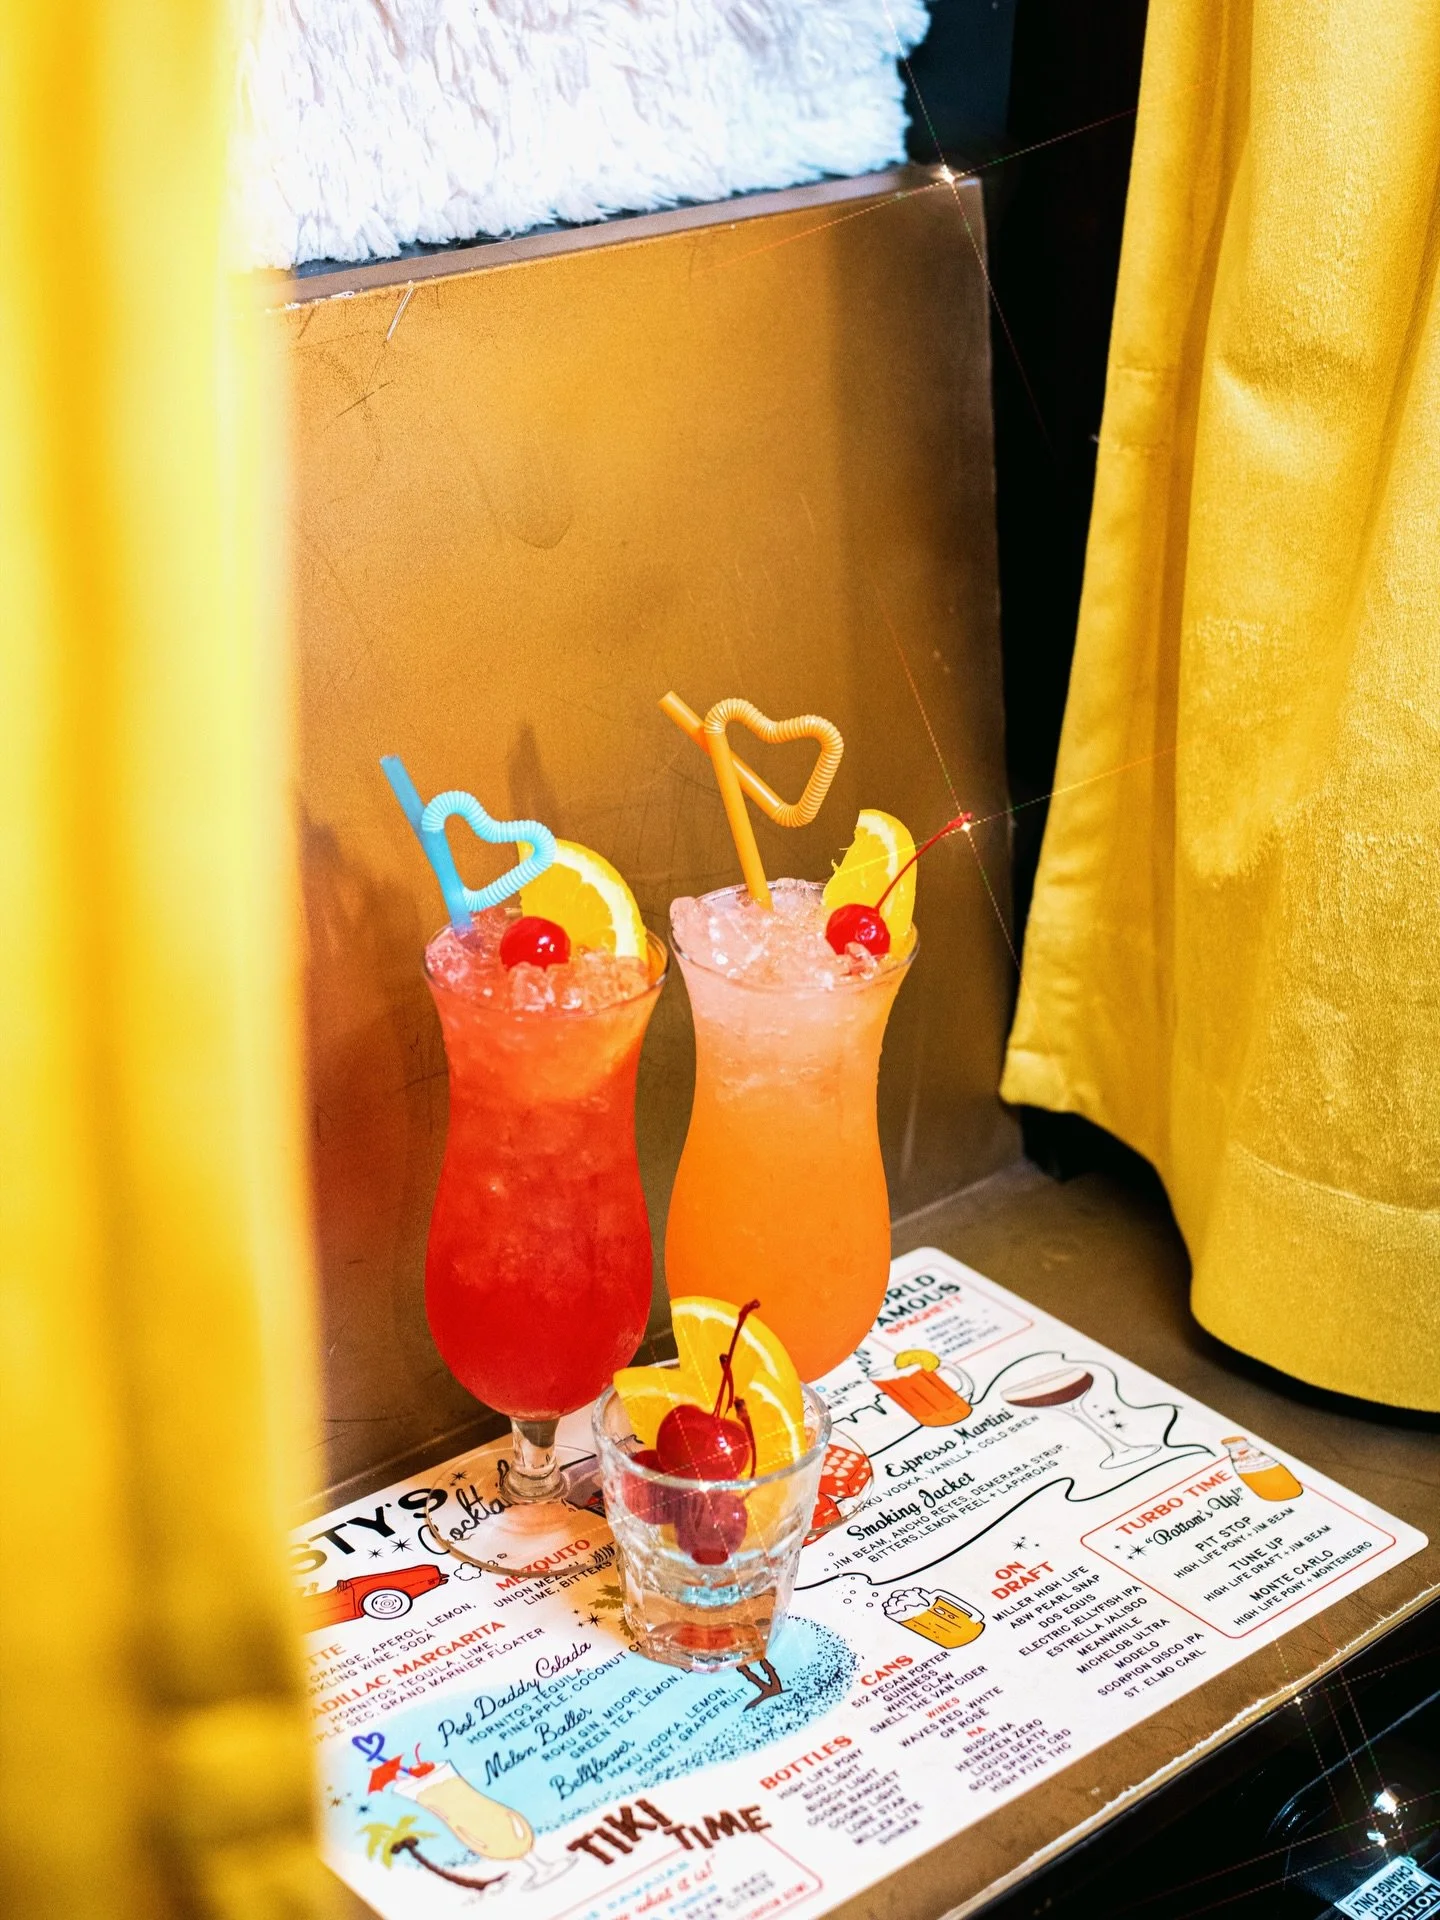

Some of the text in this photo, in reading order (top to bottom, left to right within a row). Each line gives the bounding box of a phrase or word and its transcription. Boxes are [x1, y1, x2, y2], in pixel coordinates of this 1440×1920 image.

[877, 1284, 960, 1327] AMOUS
[884, 1275, 935, 1305] RLD
[883, 1415, 1039, 1497] VODKA, VANILLA, COLD BREW
[886, 1408, 1013, 1477] Espresso Martini
[833, 1445, 1069, 1570] JIM BEAM, ANCHO REYES, DEMERARA SYRUP,
[847, 1472, 976, 1541] Smoking Jacket
[958, 1460, 1059, 1519] PEEL LAPHROAIG
[1116, 1470, 1233, 1536] TURBO TIME
[1174, 1507, 1295, 1579] HIGH LIFE PONY JIM BEAM
[1195, 1516, 1252, 1552] PIT STOP
[1228, 1537, 1285, 1572] TUNE UP
[991, 1561, 1054, 1600] DRAFT
[995, 1561, 1026, 1580] ON
[1204, 1525, 1331, 1602] HIGH LIFE DRAFT JIM BEAM
[1233, 1541, 1372, 1627] HIGH LIFE PONY MONTENEGRO
[1249, 1550, 1333, 1602] MONTE CARLO
[494, 1586, 533, 1608] UNION
[524, 1586, 560, 1605] LIME,
[991, 1565, 1089, 1622] MILLER HIGH LIFE
[1009, 1574, 1100, 1629] ABW PEARL SNAP
[1038, 1593, 1096, 1629] DOS EQUIS
[372, 1602, 477, 1654] APEROL, LEMON,
[1018, 1584, 1142, 1657] ELECTRIC JELLYFISH IPA
[1046, 1597, 1148, 1658] ESTRELLA JALISCO
[1076, 1617, 1171, 1675] MICHELOB ULTRA
[1077, 1616, 1143, 1657] MEANWHILE
[361, 1633, 436, 1671] WINE, SODA
[381, 1628, 545, 1711] GRAND MARNIER FLOATER
[392, 1621, 506, 1677] MARGARITA
[861, 1655, 913, 1686] CANS
[1097, 1632, 1204, 1697] SCORPION DISCO IPA
[1114, 1640, 1160, 1670] MODELO
[1124, 1648, 1206, 1699] ST. ELMO CARL
[328, 1661, 461, 1723] HORNITOS TEQUILA,
[437, 1641, 592, 1748] Pool Daddy Colada
[467, 1667, 590, 1744] HORNITOS TEQUILA,
[498, 1652, 627, 1740] PINEAPPLE, COCONUT
[851, 1651, 951, 1709] 512 PECAN PORTER
[870, 1665, 988, 1734] SMELL THE VAN CIDER
[882, 1669, 939, 1702] GUINNESS
[884, 1671, 955, 1713] WHITE CLAW
[541, 1686, 648, 1762] ROKU MIDORI,
[570, 1676, 683, 1759] GREEN TEA, LEMON,
[607, 1687, 731, 1779] HAKU VODKA, LEMON,
[635, 1687, 749, 1776] HONEY, GRAPEFRUIT
[898, 1686, 1004, 1748] WAVES RED, WHITE
[925, 1697, 960, 1719] WINES
[940, 1727, 957, 1739] OR
[967, 1726, 986, 1737] NA
[484, 1707, 593, 1786] Melon Baller
[759, 1735, 852, 1791] BOTTLES
[954, 1719, 1043, 1772] HEINEKEN ZERO
[962, 1722, 1016, 1754] BUSCH NA
[968, 1728, 1071, 1791] GOOD SPIRITS CBD
[970, 1729, 1049, 1777] LIQUID DEATH
[777, 1748, 864, 1800] HIGH LIFE PONY
[802, 1763, 861, 1800] BUD LIGHT
[845, 1767, 880, 1789] LIGHT
[990, 1742, 1072, 1793] HIGH FIVE THC
[567, 1799, 772, 1865] TIKI TIME
[1350, 1893, 1379, 1916] ONLY
[1370, 1893, 1405, 1920] EXACT
[1372, 1866, 1413, 1898] CHANGE
[1393, 1888, 1440, 1920] NOTIC
[1397, 1880, 1423, 1898] USE
